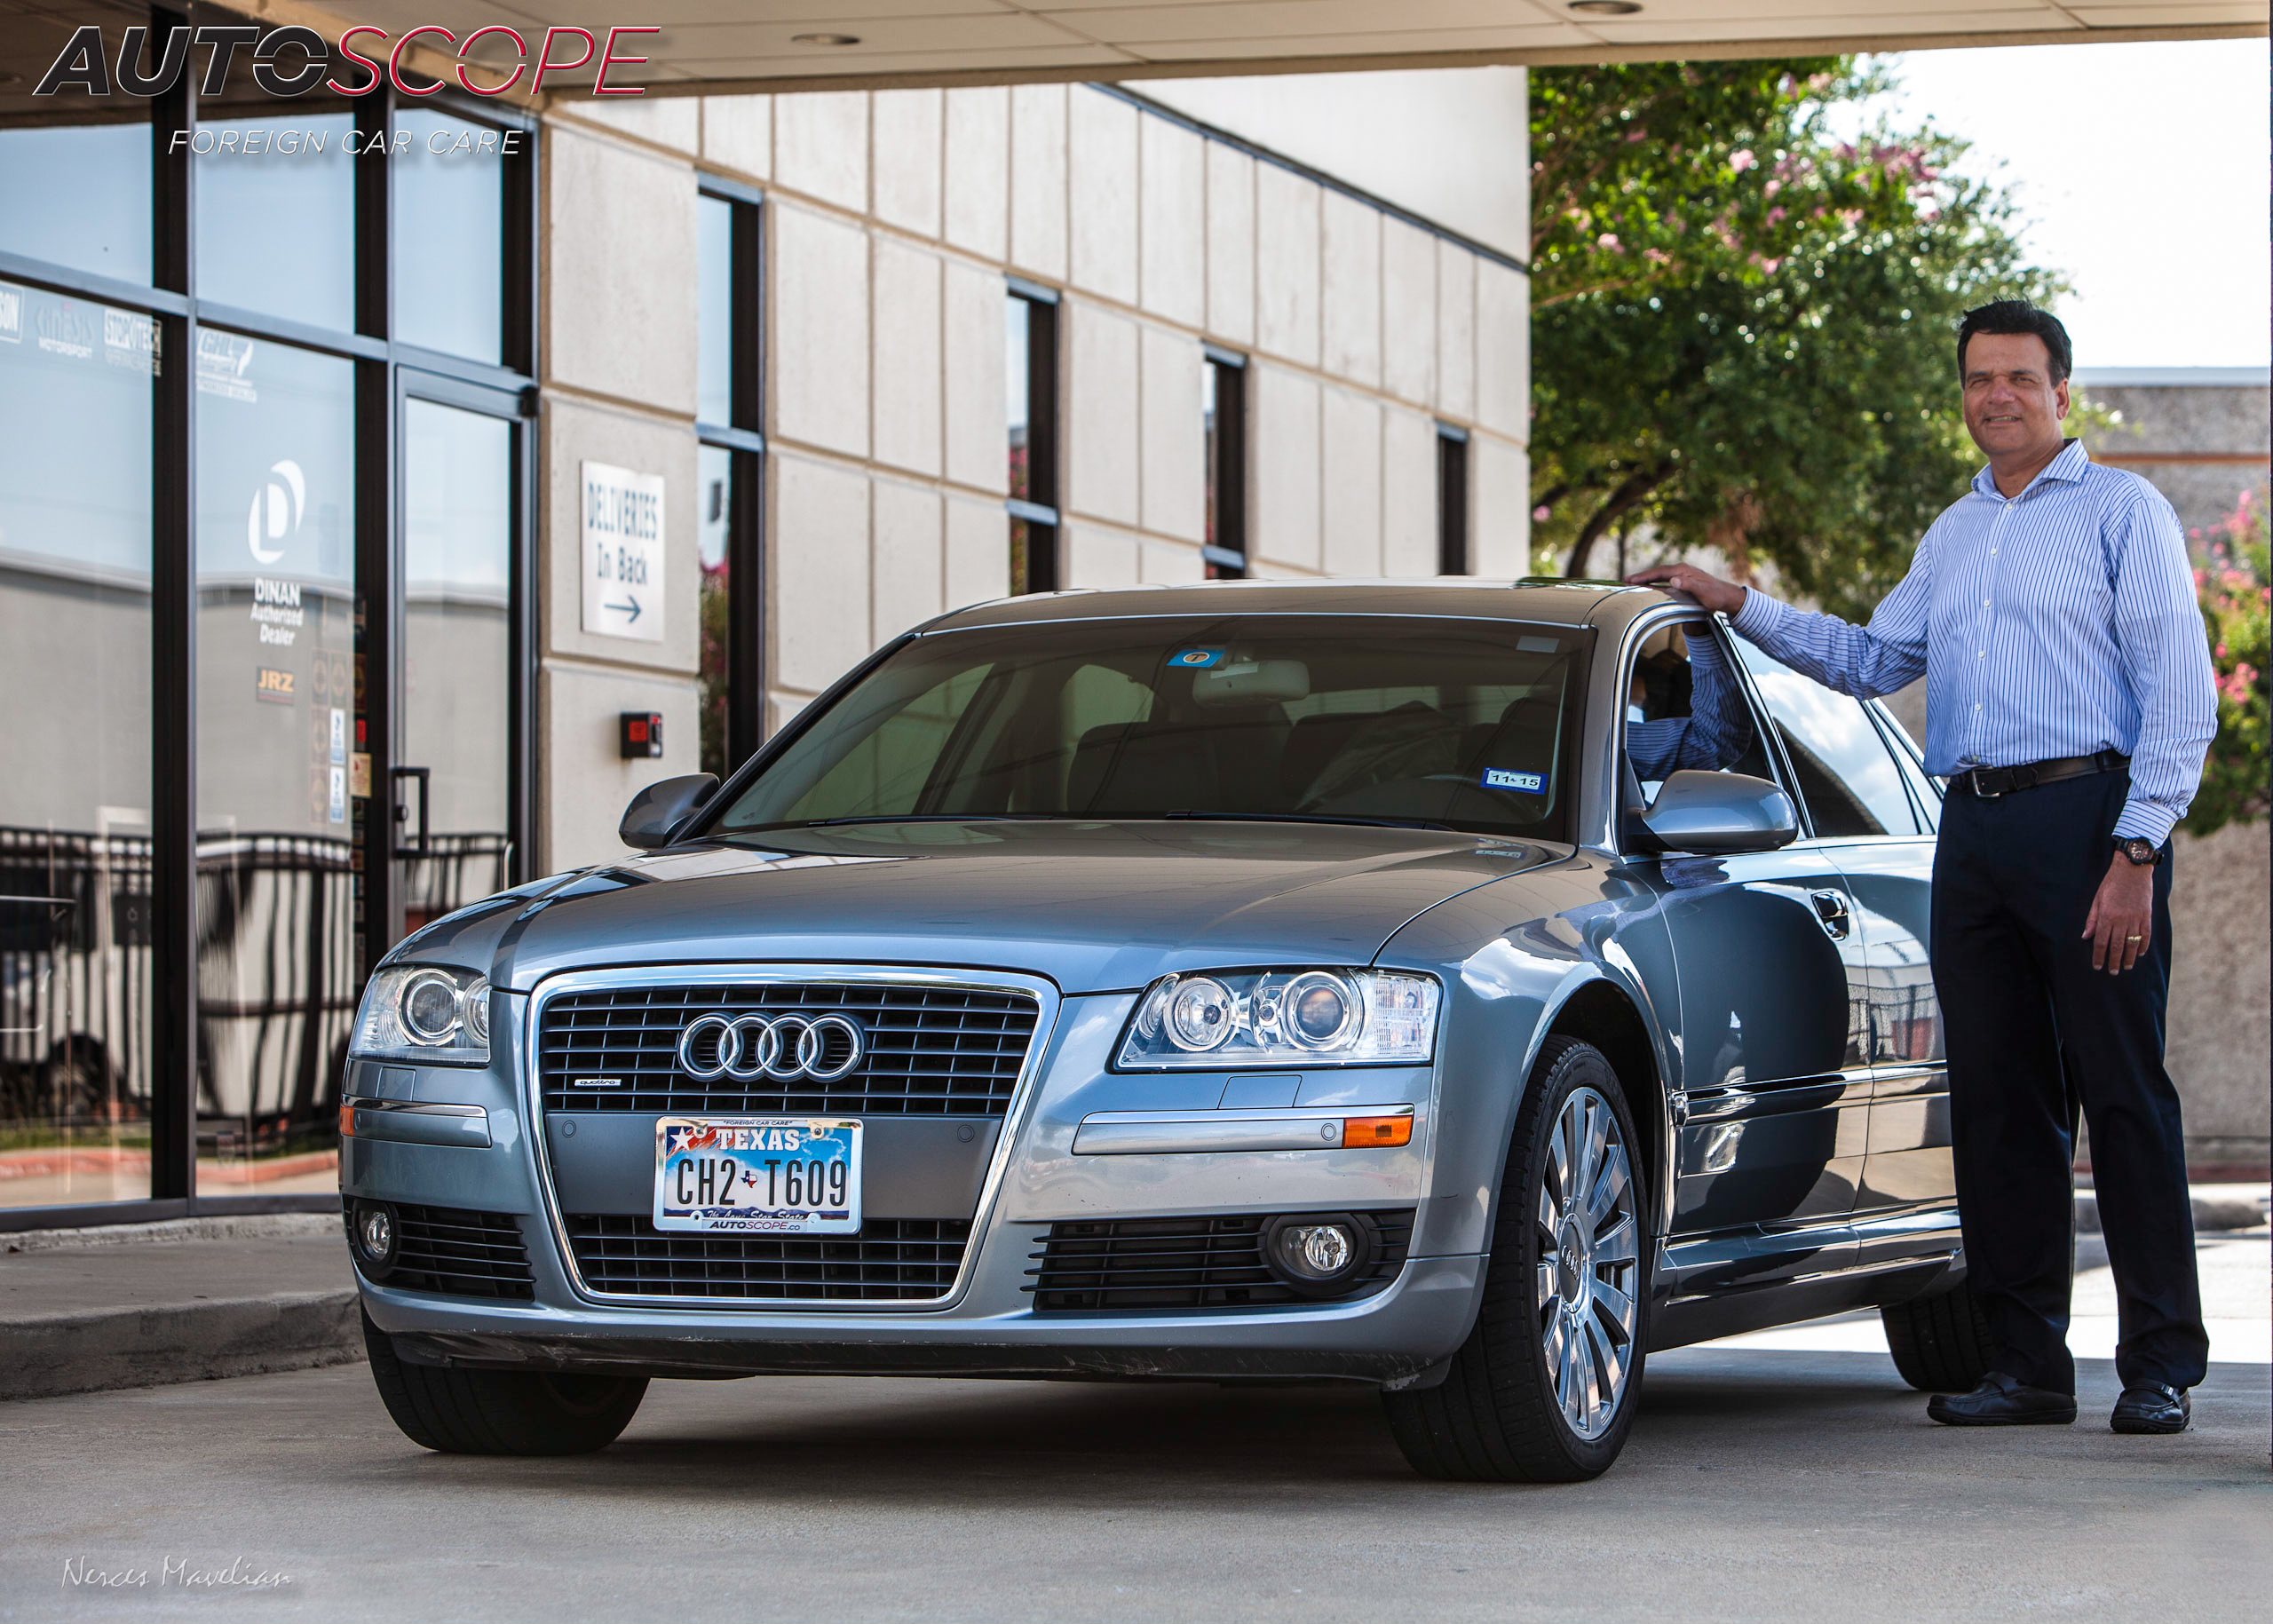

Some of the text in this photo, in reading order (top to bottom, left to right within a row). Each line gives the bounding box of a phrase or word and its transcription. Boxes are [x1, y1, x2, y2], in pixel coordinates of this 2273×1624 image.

[587, 482, 658, 540] DELIVERIES
[597, 542, 647, 585] In Back
[254, 576, 301, 606] DINAN
[250, 601, 304, 627] Authorized
[259, 622, 296, 646] Dealer
[257, 669, 294, 693] JRZ
[716, 1129, 800, 1151] TEXAS
[677, 1159, 846, 1207] CH2 T609
